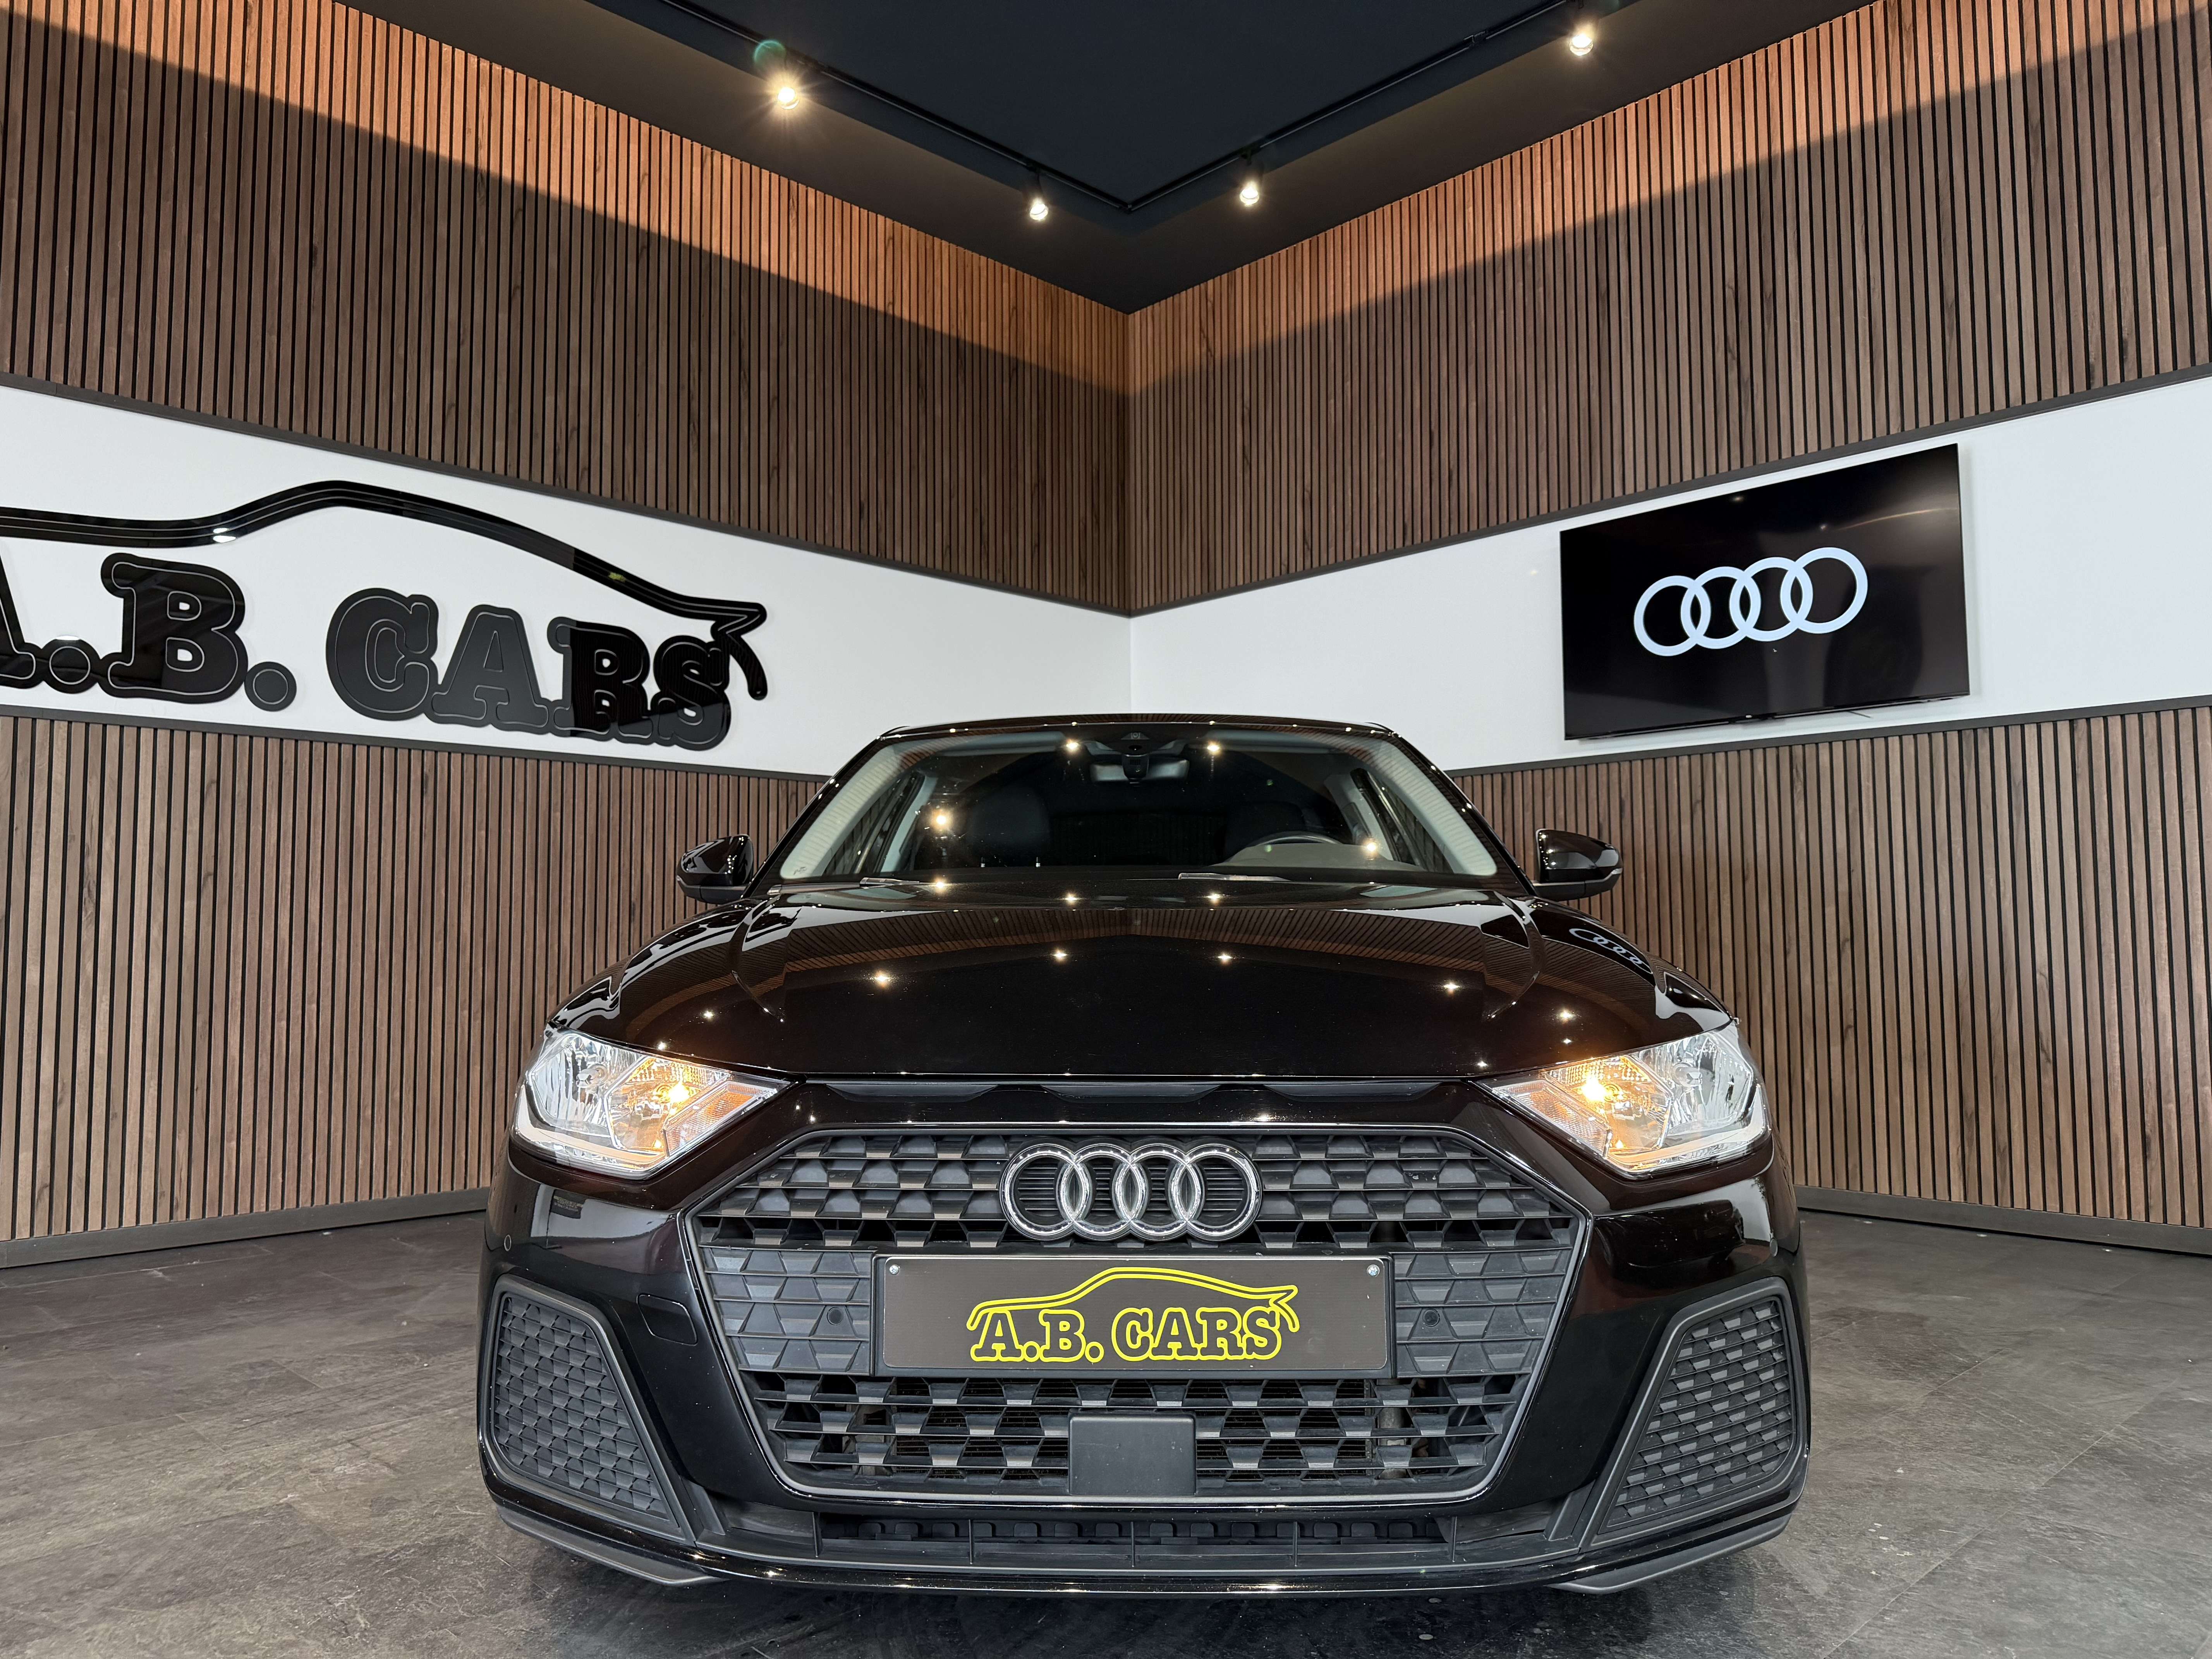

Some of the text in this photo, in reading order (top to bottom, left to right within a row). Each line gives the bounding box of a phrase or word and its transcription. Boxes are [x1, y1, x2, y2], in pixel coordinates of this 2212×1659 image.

[0, 553, 732, 751] .B. CARS
[970, 1306, 1282, 1363] A.B. CARS
